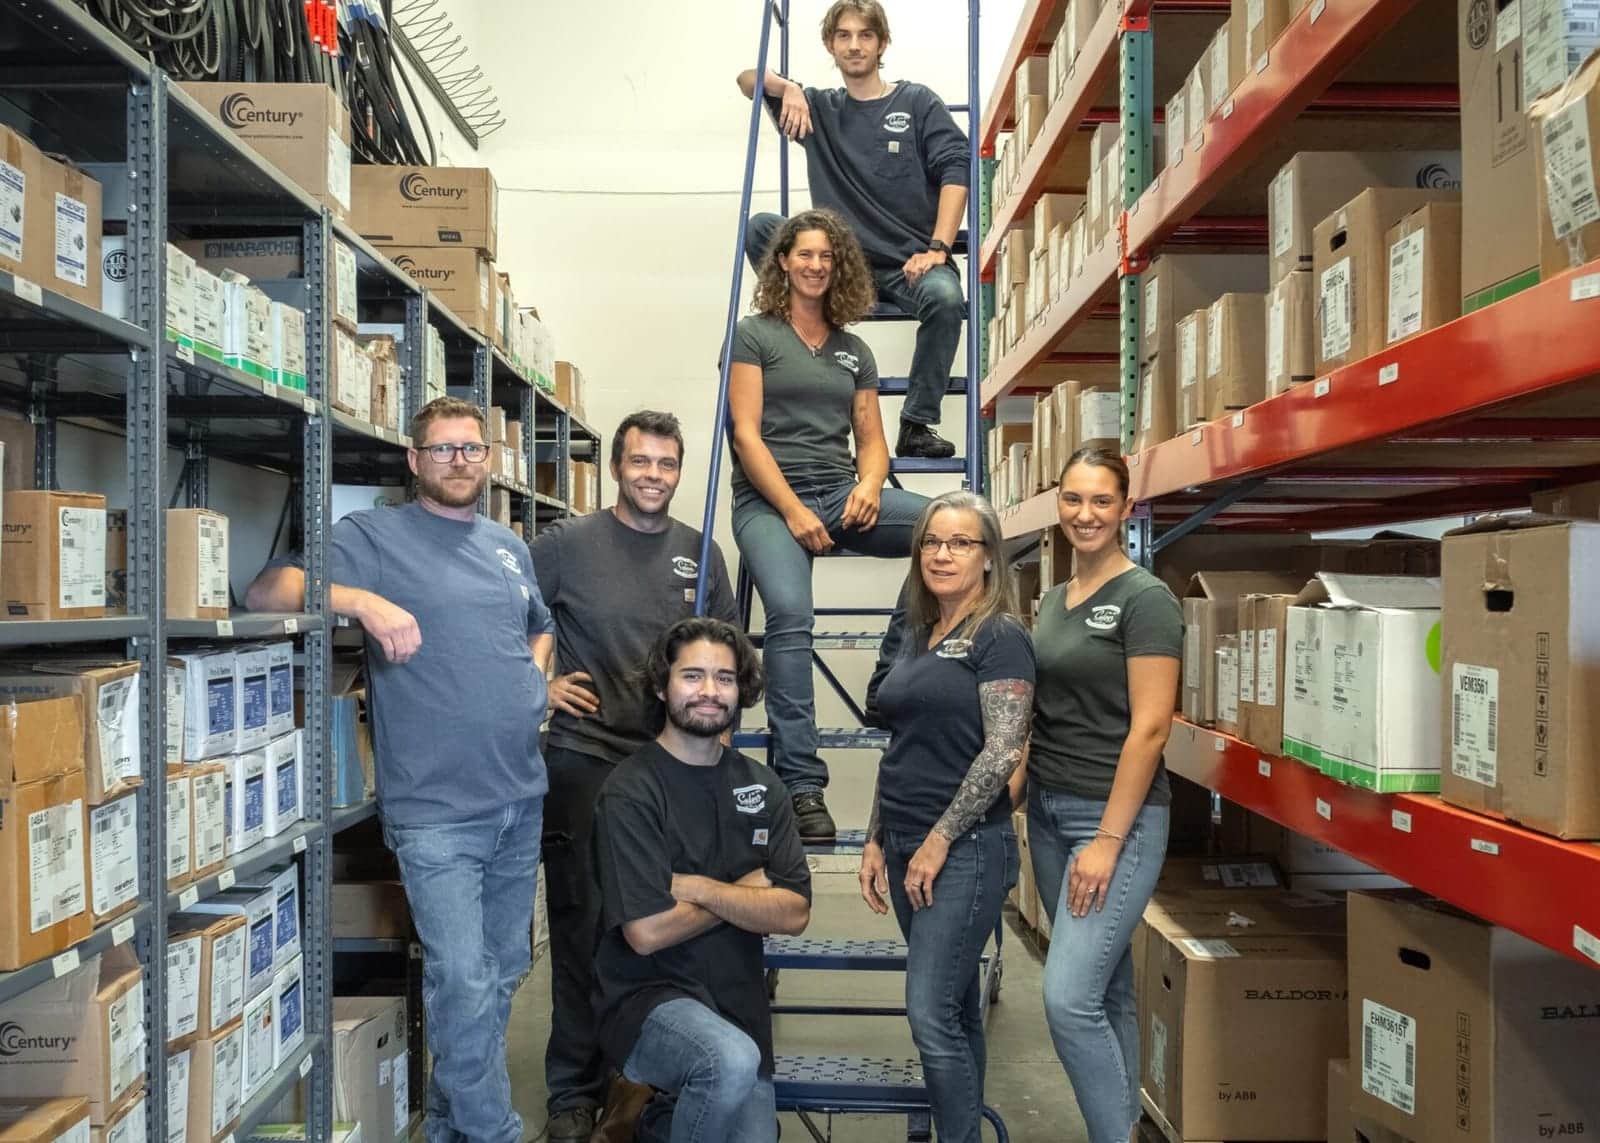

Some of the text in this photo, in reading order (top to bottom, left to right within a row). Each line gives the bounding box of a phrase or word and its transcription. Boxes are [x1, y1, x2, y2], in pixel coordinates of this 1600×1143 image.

[236, 107, 298, 127] Century
[413, 184, 463, 200] Century
[3, 523, 28, 535] tury
[1244, 989, 1332, 1001] BALDOR
[1370, 1011, 1408, 1039] EHM3615T
[7, 1035, 71, 1052] Century
[1218, 1090, 1257, 1103] by ABB
[1539, 1122, 1585, 1138] by ABB
